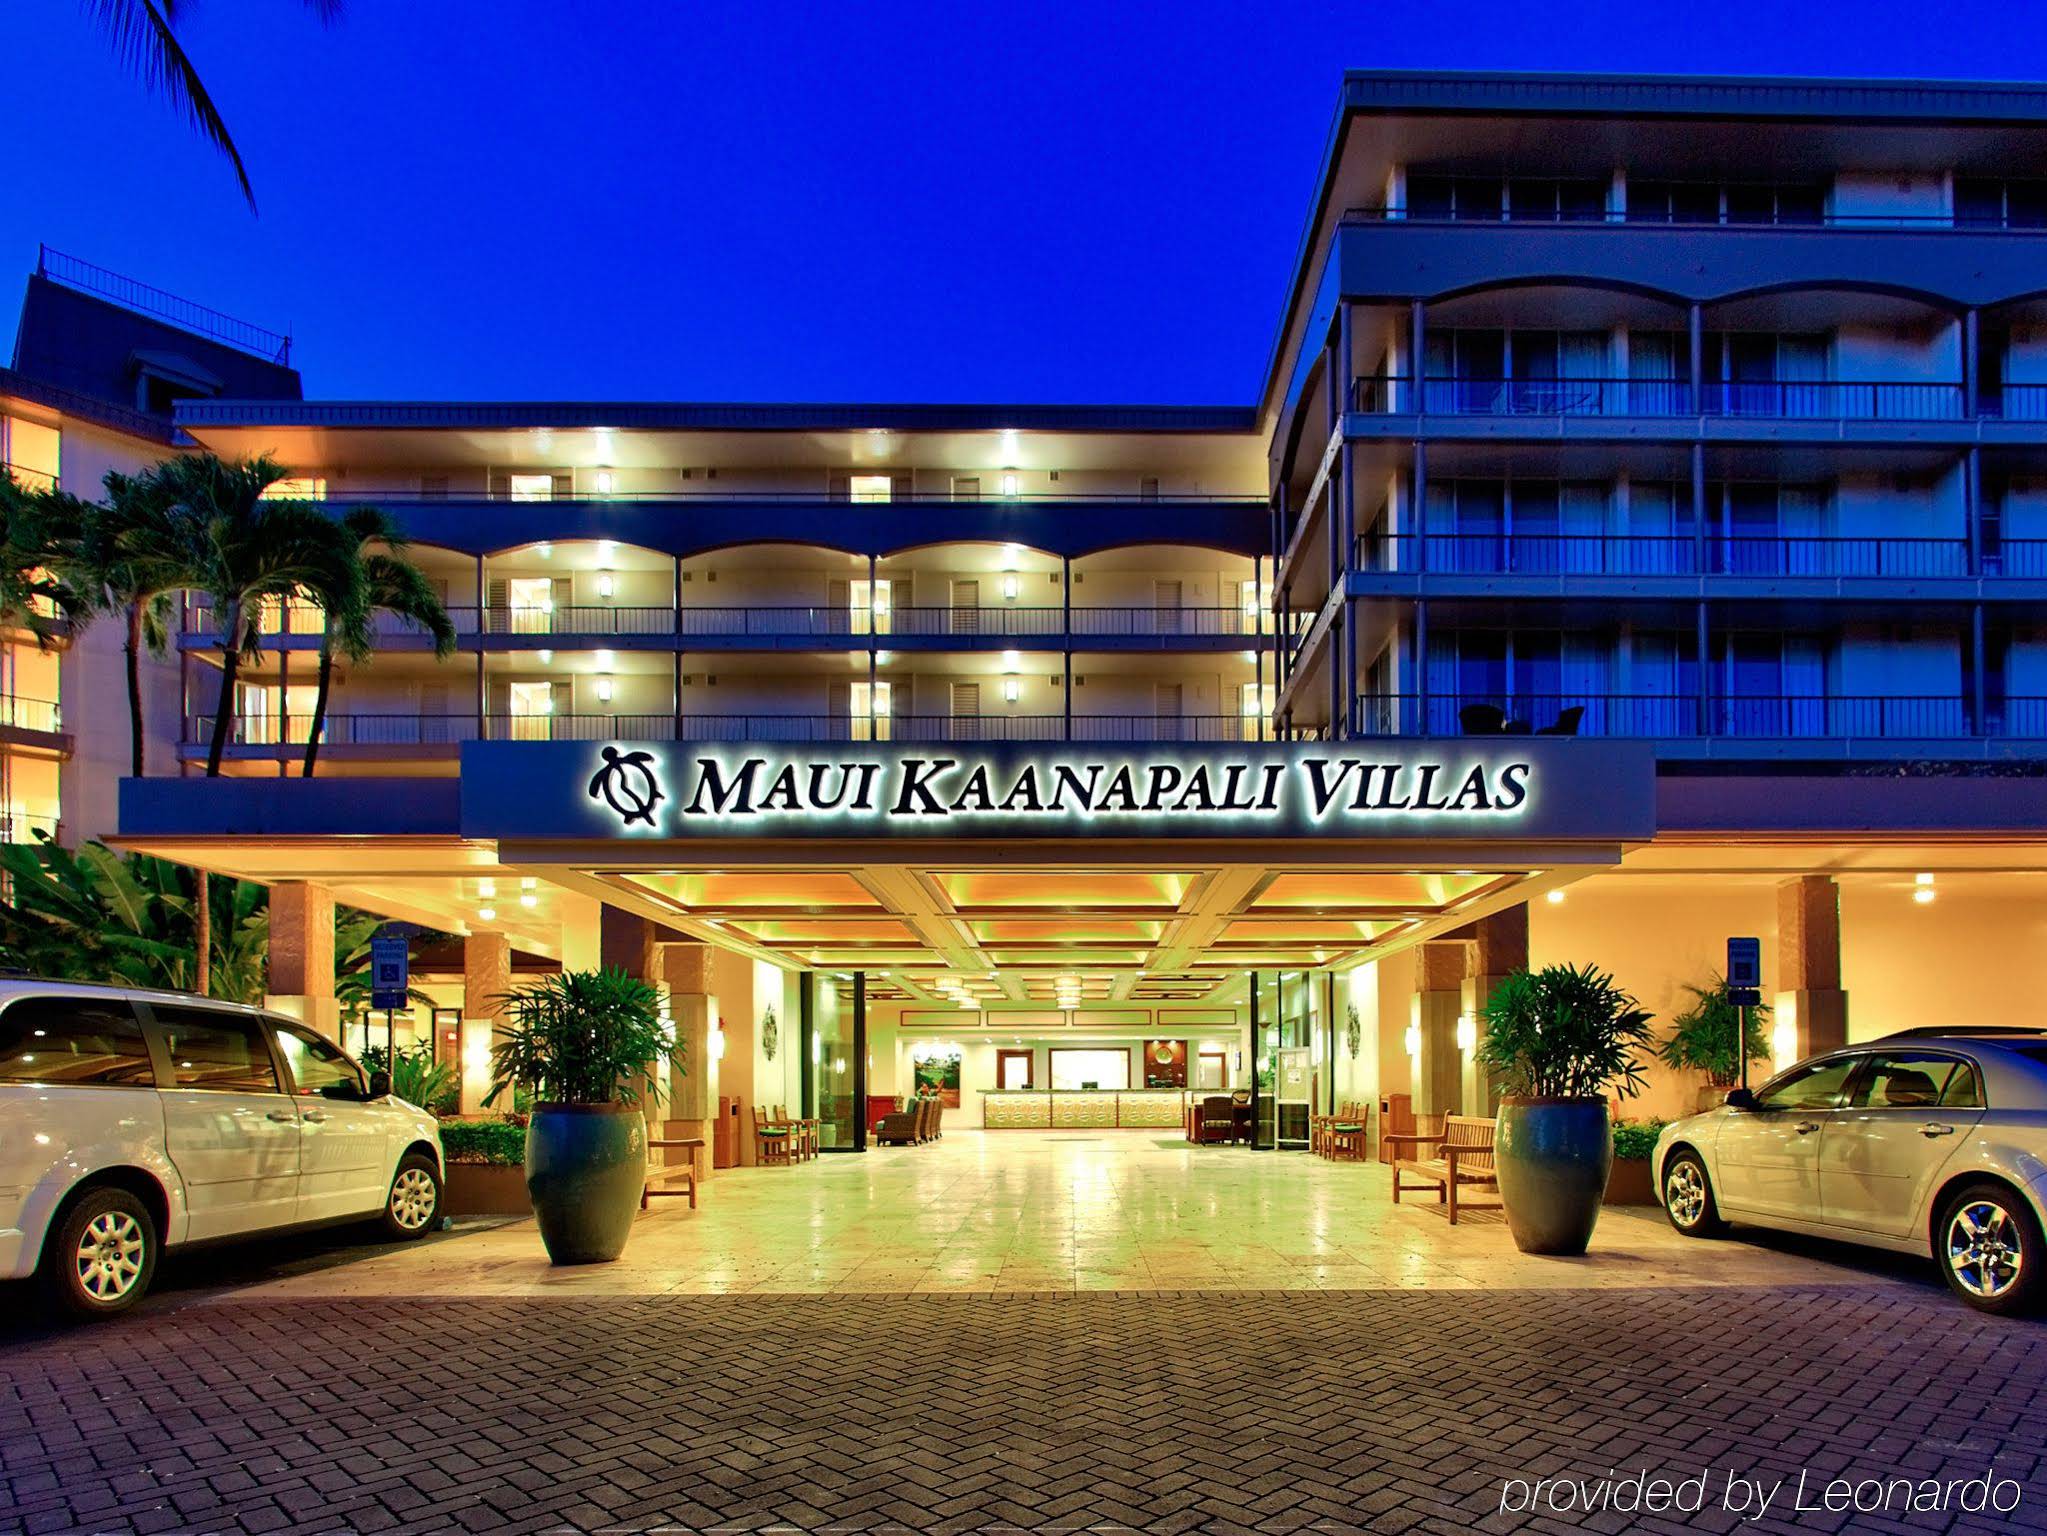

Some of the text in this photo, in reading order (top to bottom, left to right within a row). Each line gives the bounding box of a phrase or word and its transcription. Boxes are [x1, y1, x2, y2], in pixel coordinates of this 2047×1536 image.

[684, 758, 1530, 817] MAUI KAANAPALI VILLAS
